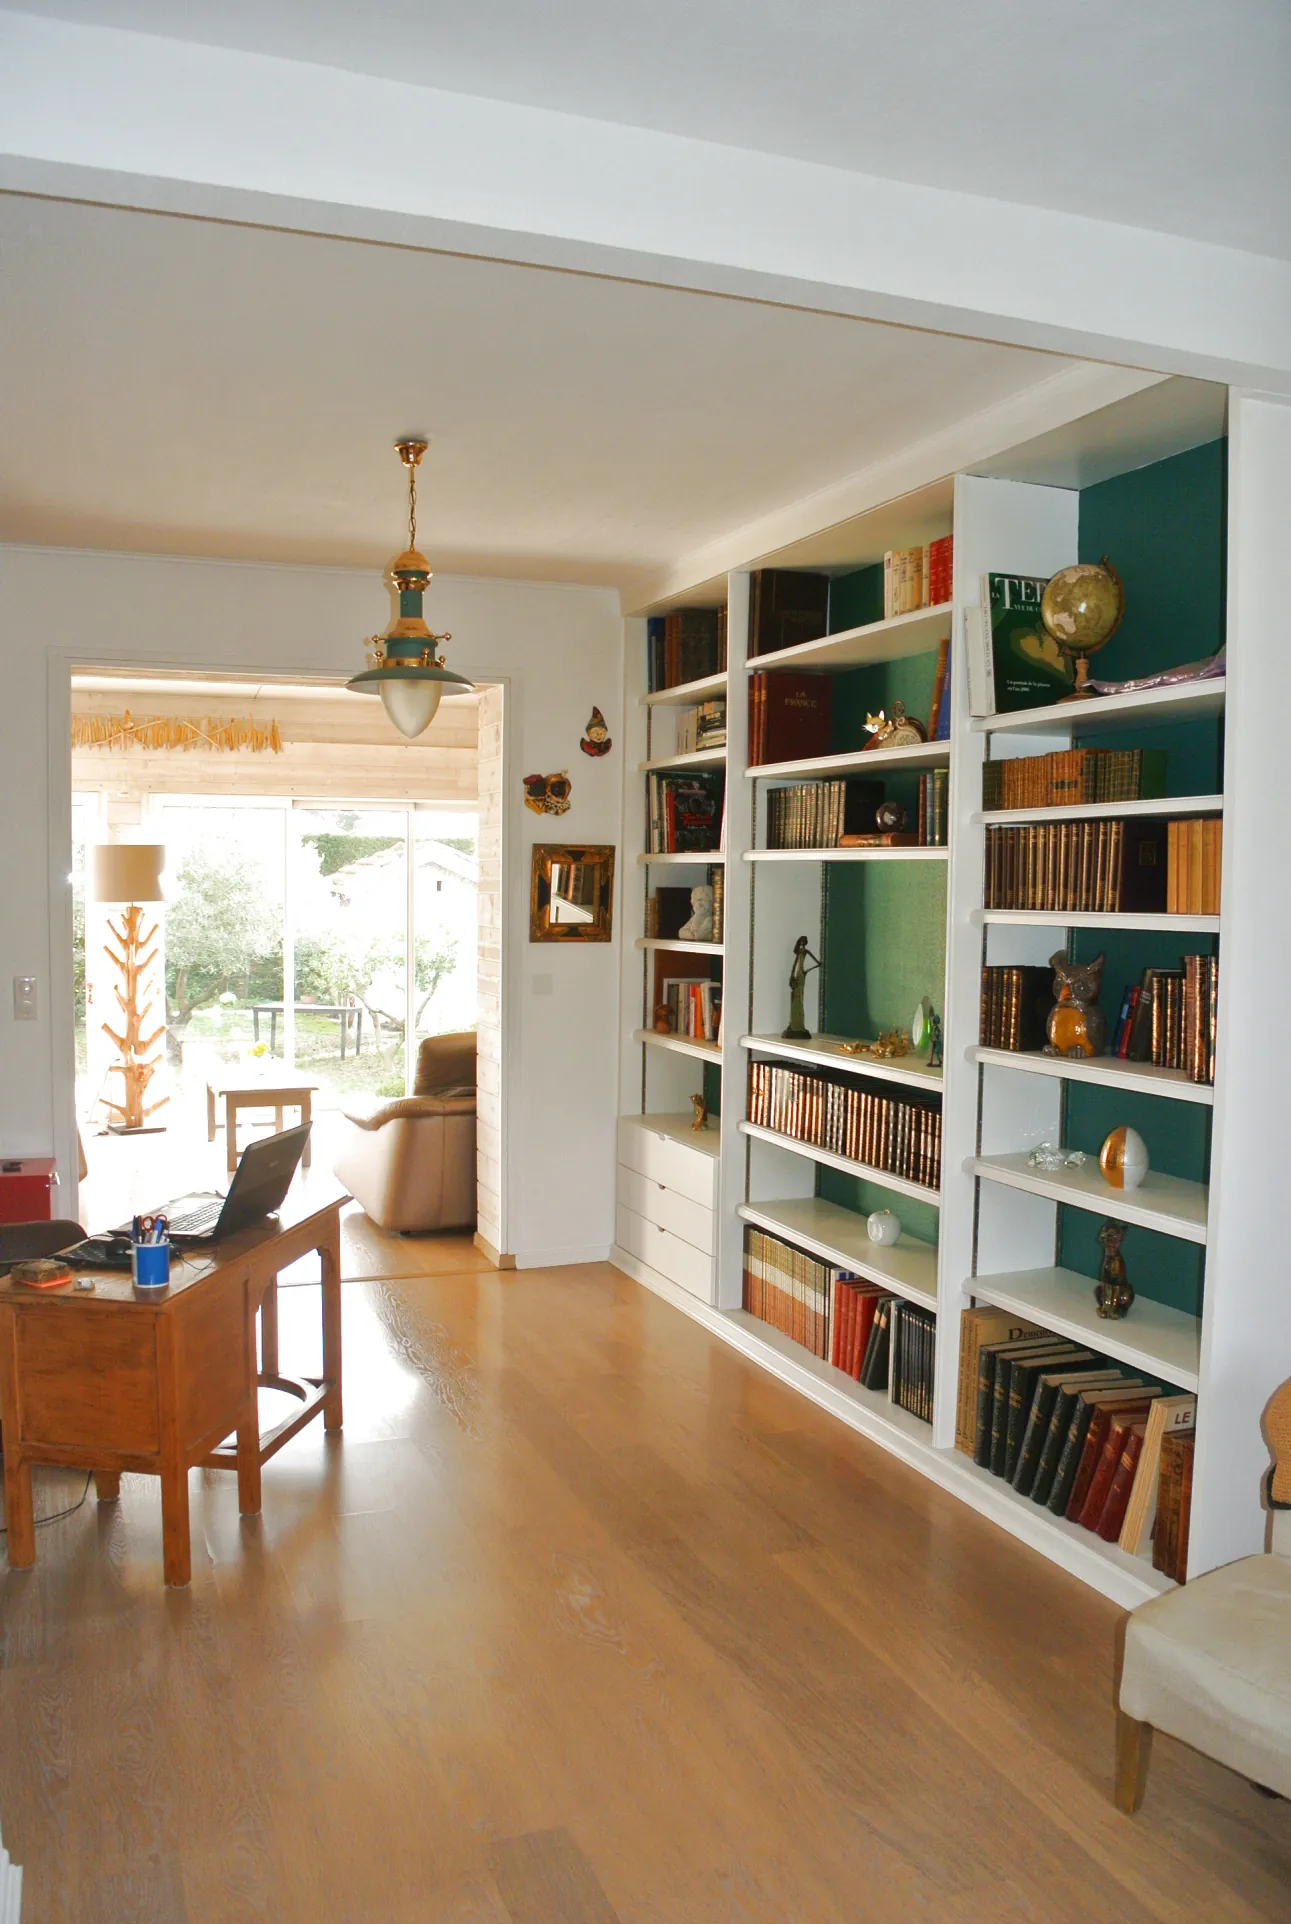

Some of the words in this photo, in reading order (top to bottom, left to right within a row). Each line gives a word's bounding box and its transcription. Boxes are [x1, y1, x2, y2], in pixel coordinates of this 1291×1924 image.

[795, 690, 807, 698] LA
[784, 697, 817, 708] FRANCE
[1174, 1411, 1191, 1425] LE
